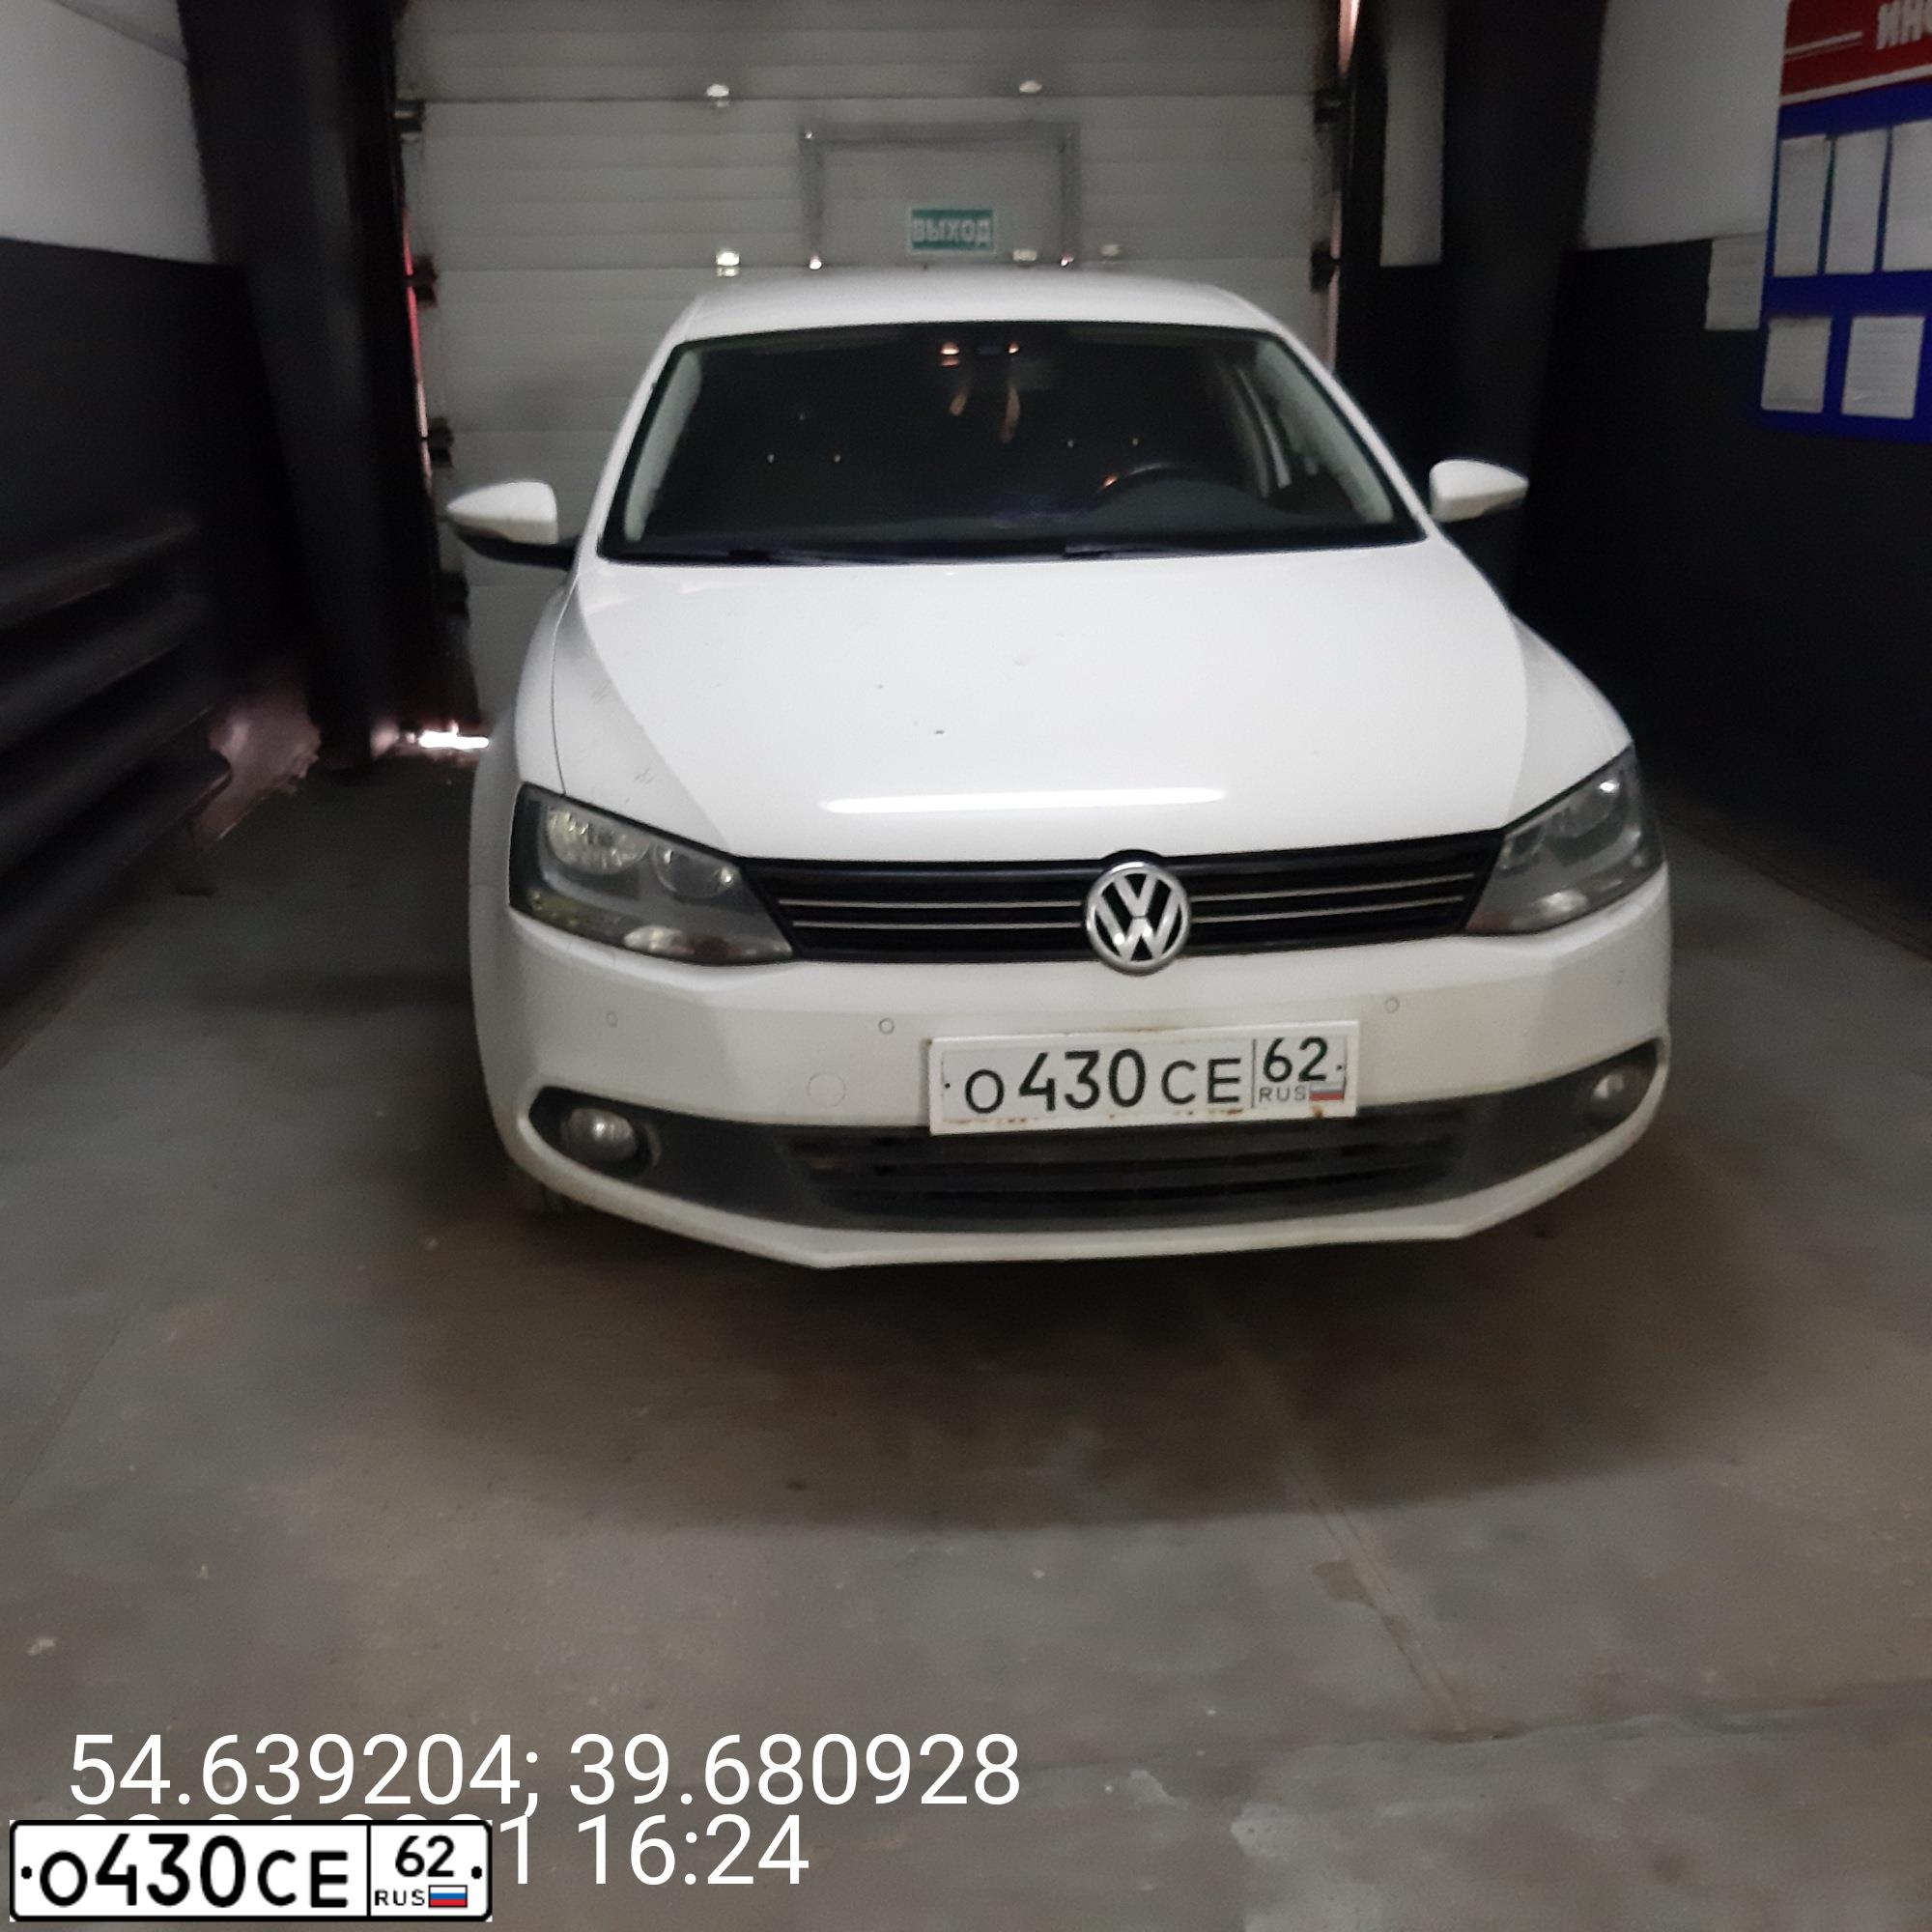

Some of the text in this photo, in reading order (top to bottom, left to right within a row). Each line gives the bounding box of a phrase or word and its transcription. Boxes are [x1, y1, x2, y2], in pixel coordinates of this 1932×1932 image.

[912, 218, 991, 246] ВЫХОД
[1263, 1037, 1329, 1082] 62
[1259, 1085, 1306, 1102] RUS
